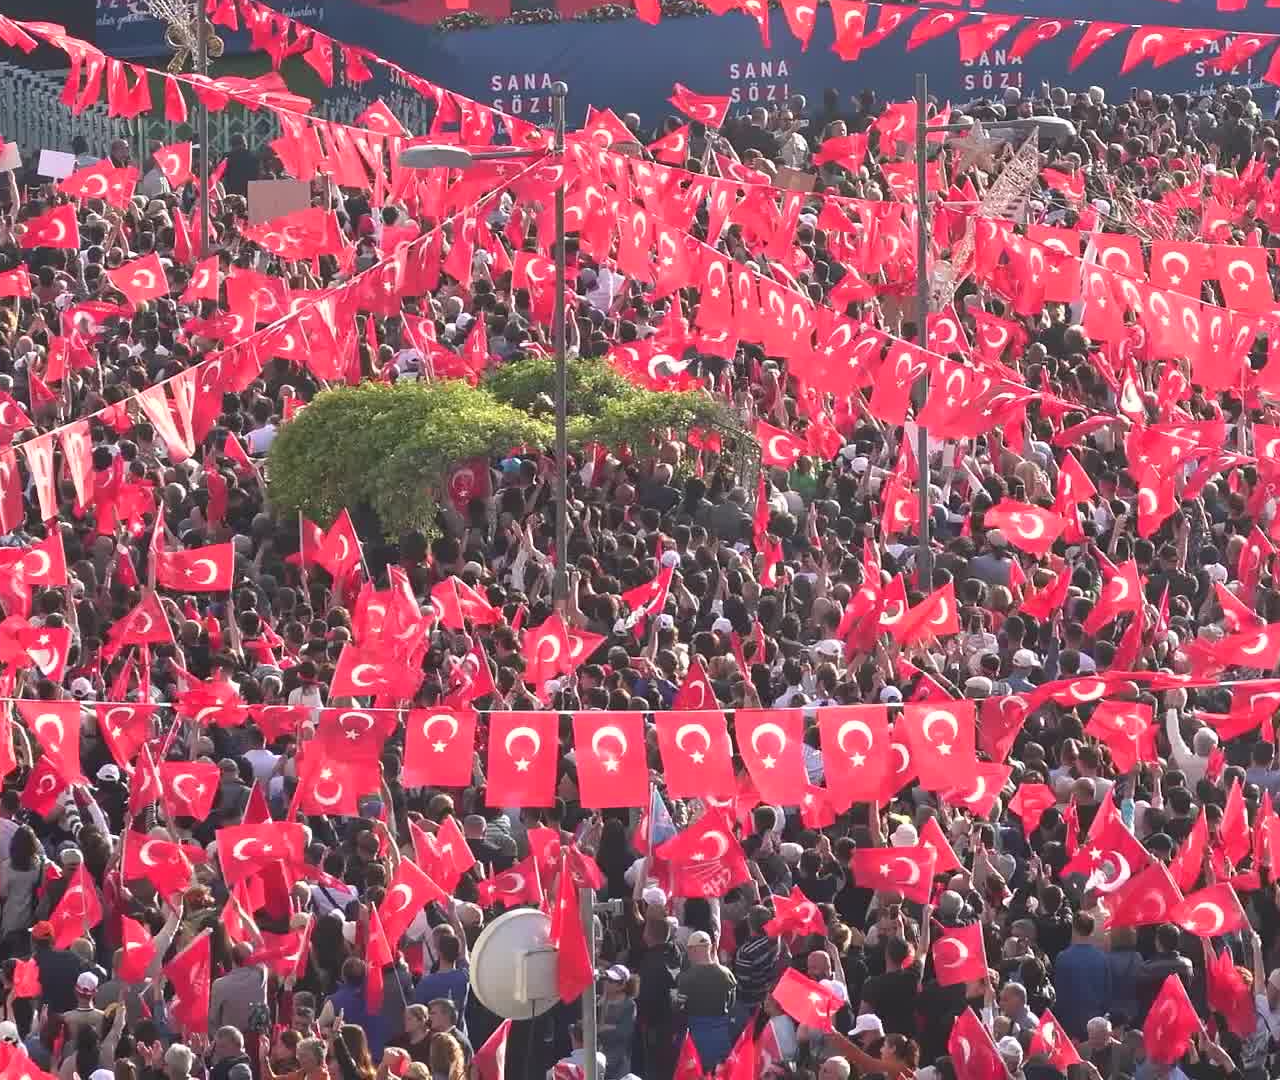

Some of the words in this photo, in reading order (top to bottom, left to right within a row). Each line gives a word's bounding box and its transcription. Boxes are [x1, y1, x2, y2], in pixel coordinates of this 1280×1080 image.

[730, 61, 789, 79] SANA
[492, 74, 552, 91] SANA
[965, 71, 1023, 90] SÖZ!
[732, 83, 790, 102] SÖZ!
